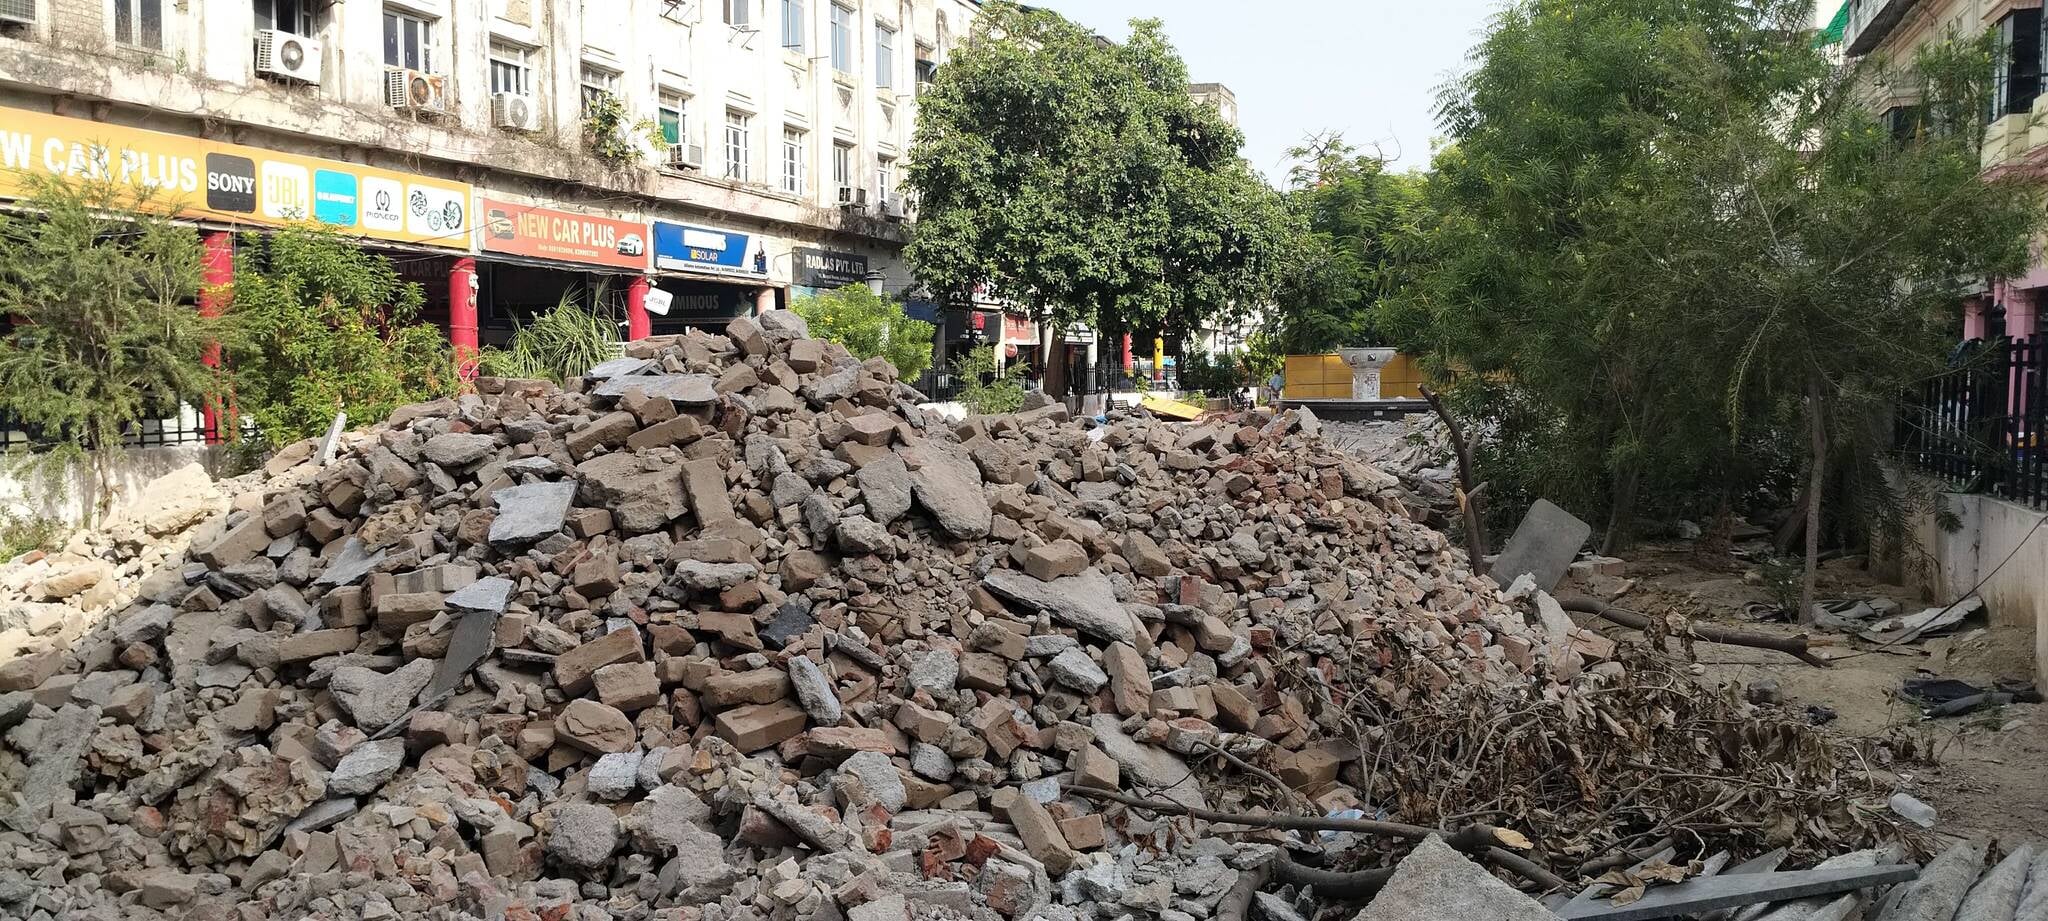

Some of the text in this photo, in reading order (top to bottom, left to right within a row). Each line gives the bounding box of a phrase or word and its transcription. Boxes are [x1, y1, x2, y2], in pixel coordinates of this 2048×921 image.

[43, 137, 114, 181] CAR
[120, 147, 198, 192] PLUS
[208, 172, 254, 194] SONY
[268, 175, 304, 207] JBL
[517, 212, 615, 249] NEW CAR PLUS
[805, 254, 835, 271] RADLAS
[835, 259, 850, 273] PVT.
